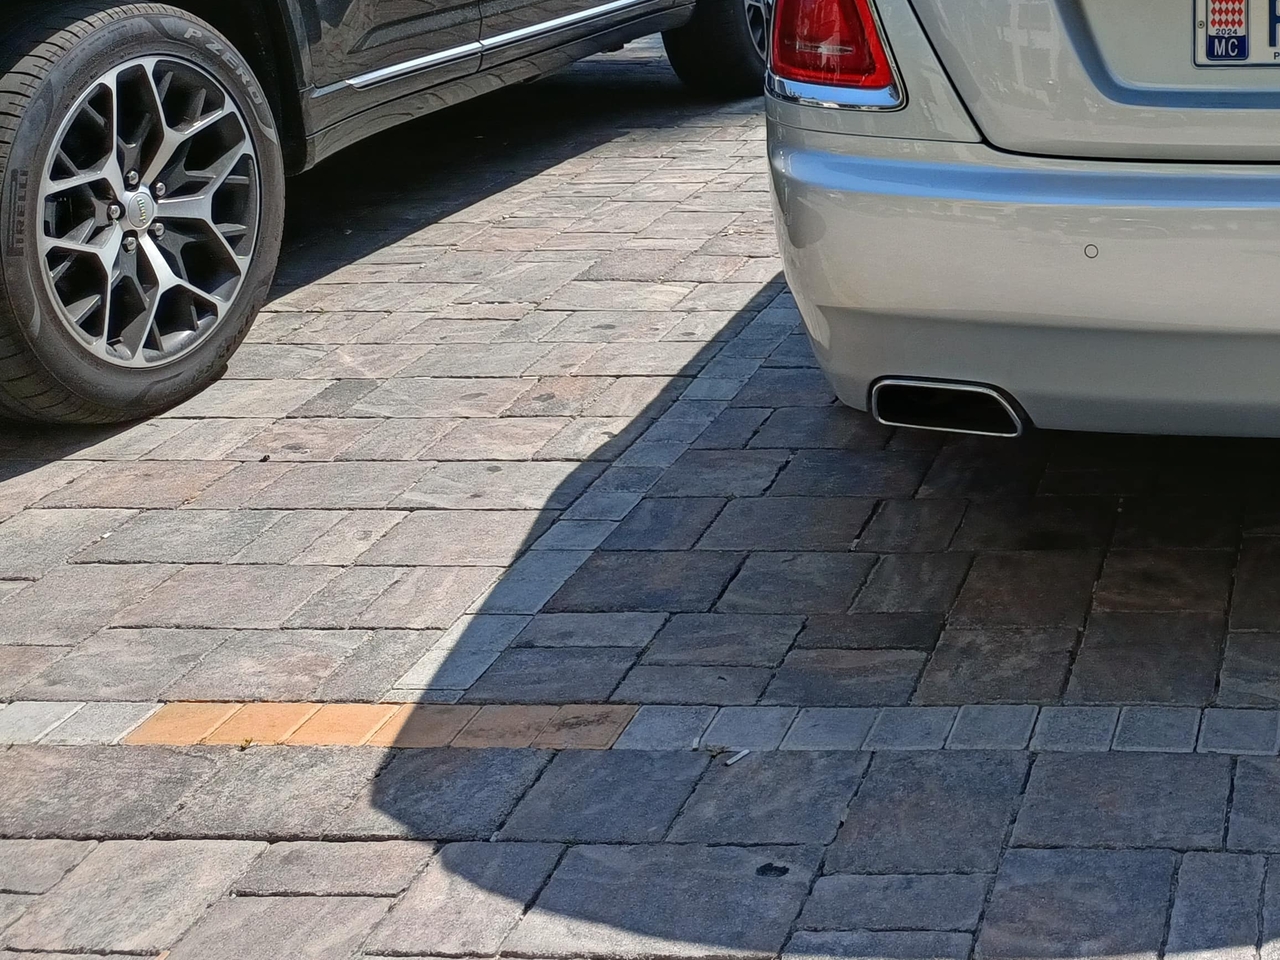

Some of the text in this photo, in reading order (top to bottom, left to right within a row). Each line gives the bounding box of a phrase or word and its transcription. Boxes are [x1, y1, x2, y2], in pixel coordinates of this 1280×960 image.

[184, 27, 202, 39] P
[205, 39, 262, 105] ZERO
[1214, 38, 1239, 57] MC
[6, 168, 28, 257] PIRELLI
